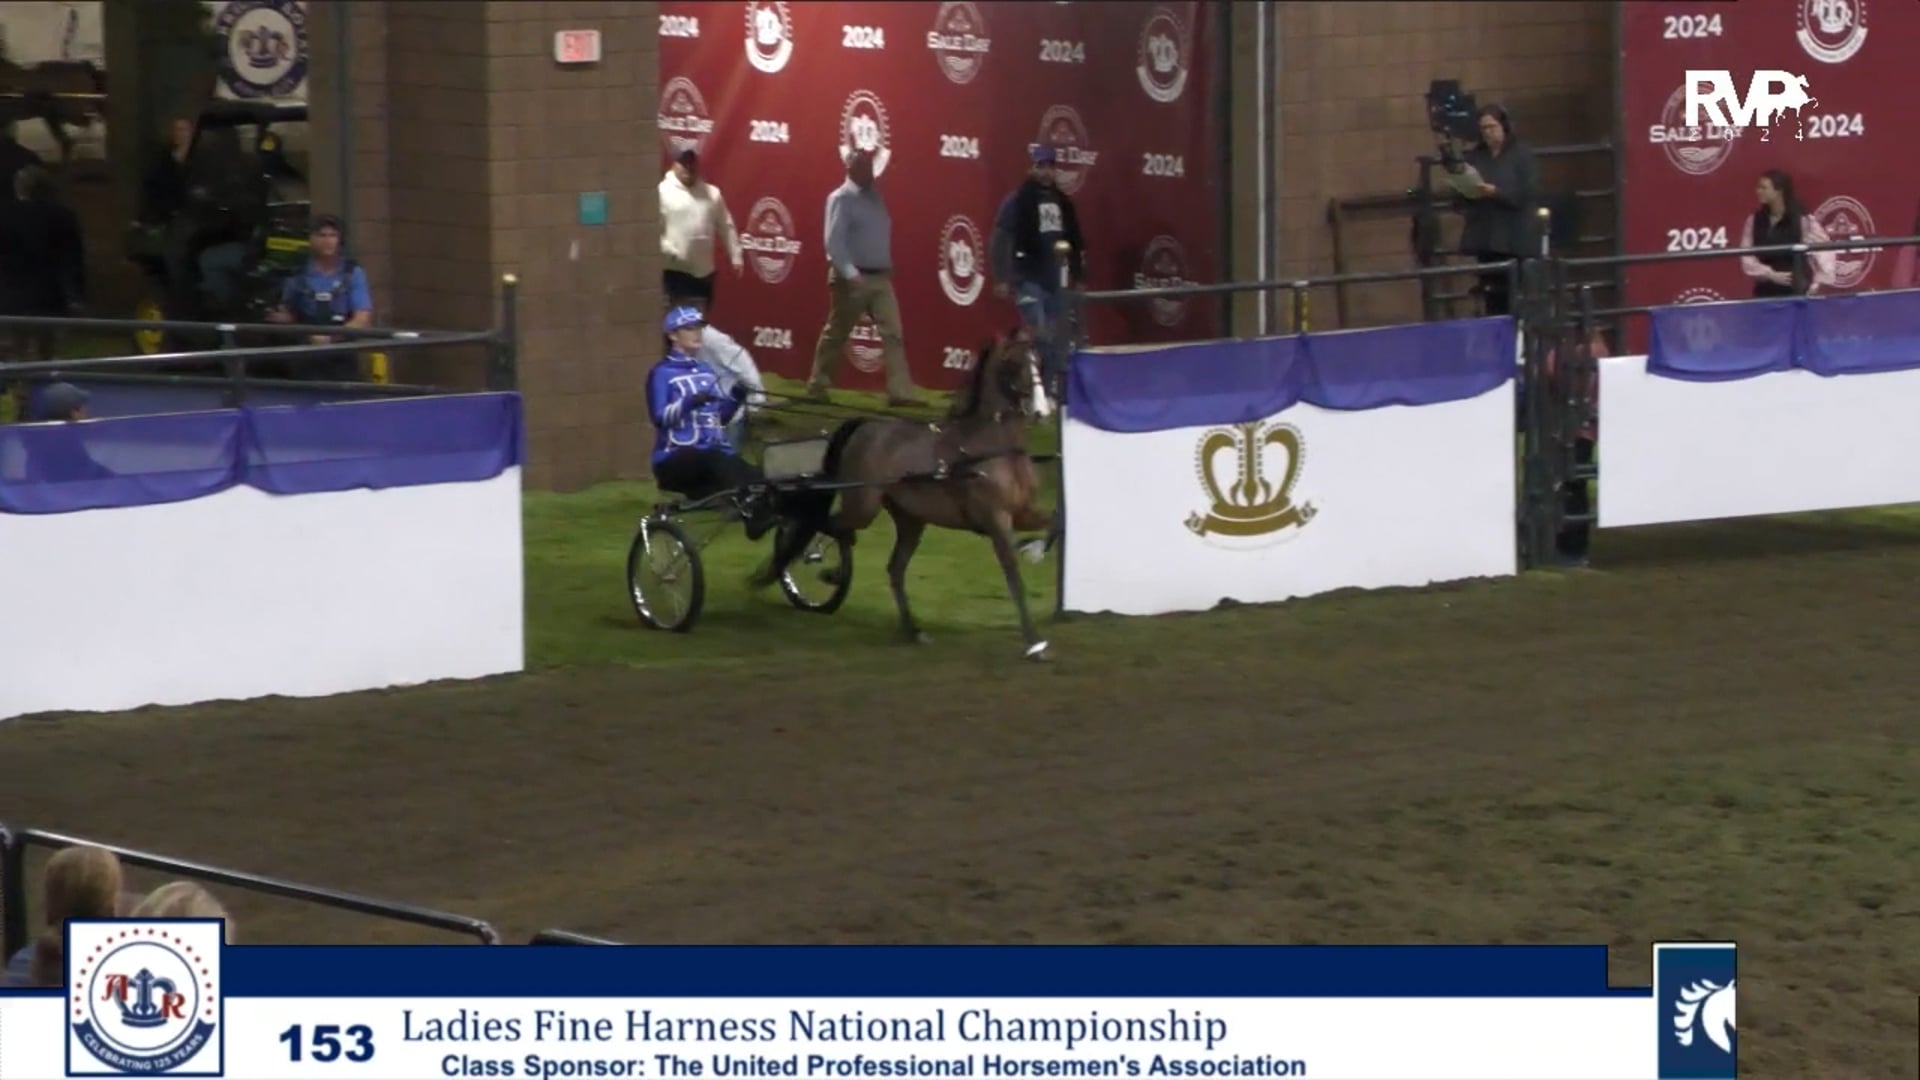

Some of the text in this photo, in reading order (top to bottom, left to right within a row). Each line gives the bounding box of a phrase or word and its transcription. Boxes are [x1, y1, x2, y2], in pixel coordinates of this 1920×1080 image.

[659, 15, 699, 37] 2024
[842, 25, 884, 49] 2024
[1663, 14, 1723, 38] 2024
[1039, 39, 1085, 63] 2024
[749, 120, 790, 143] 2024
[1807, 114, 1865, 138] 2024
[940, 134, 980, 159] 2024
[1142, 152, 1185, 177] 2024
[1667, 227, 1728, 251] 2024
[753, 326, 793, 349] 2024
